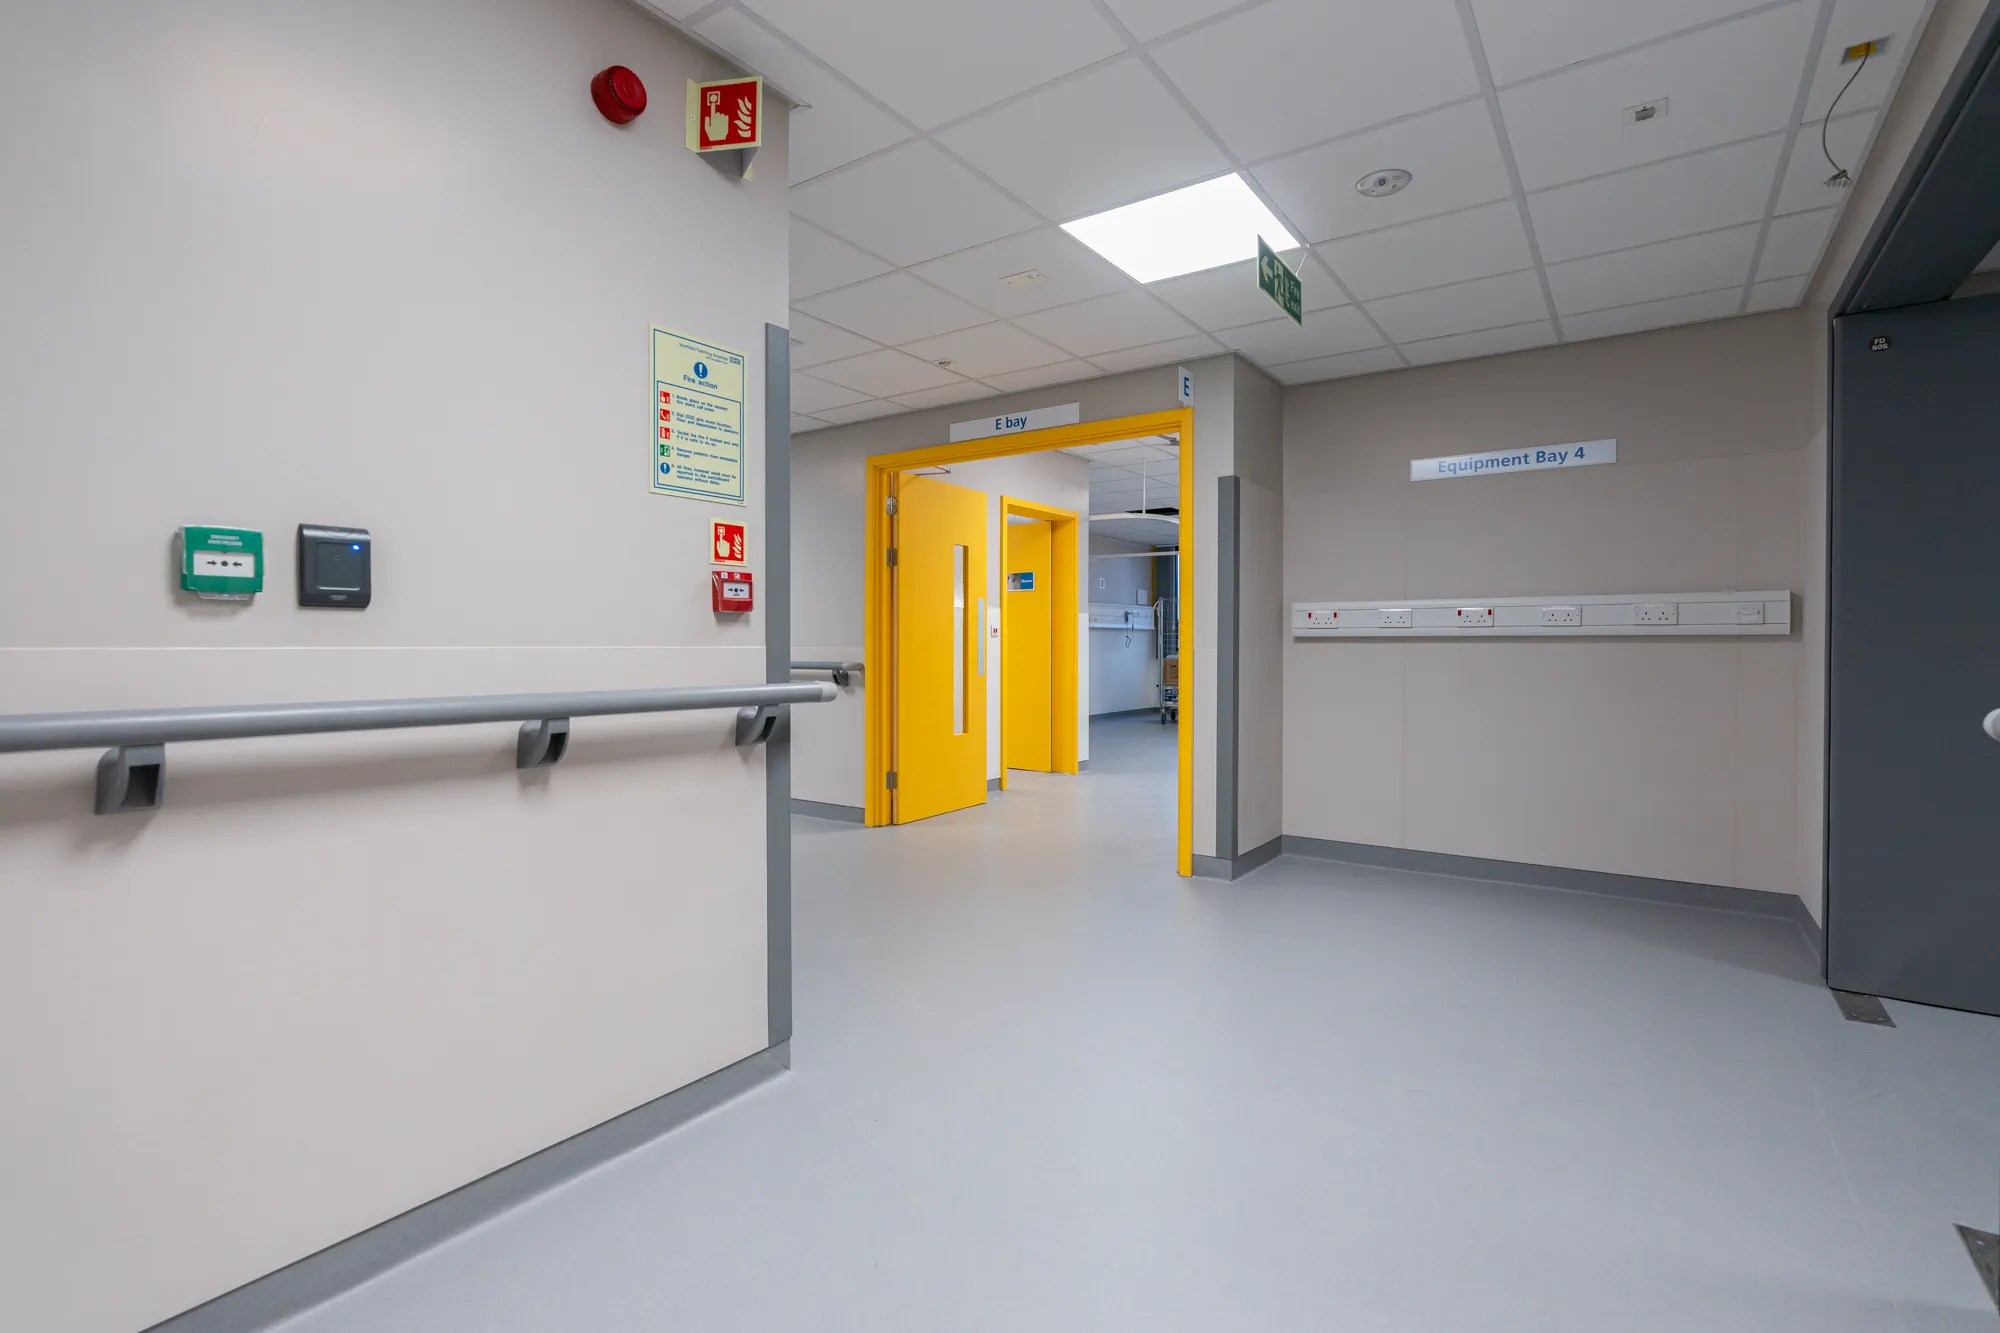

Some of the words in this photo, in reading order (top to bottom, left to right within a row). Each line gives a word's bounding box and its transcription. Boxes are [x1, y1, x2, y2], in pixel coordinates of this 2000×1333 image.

[1290, 280, 1300, 299] Fire
[684, 375, 695, 384] Fire
[698, 380, 718, 390] action
[1184, 376, 1190, 397] E
[995, 418, 1002, 430] E
[1005, 415, 1027, 429] bay
[1438, 452, 1530, 474] Equipment
[1536, 449, 1569, 465] Bay
[1574, 446, 1586, 460] 4
